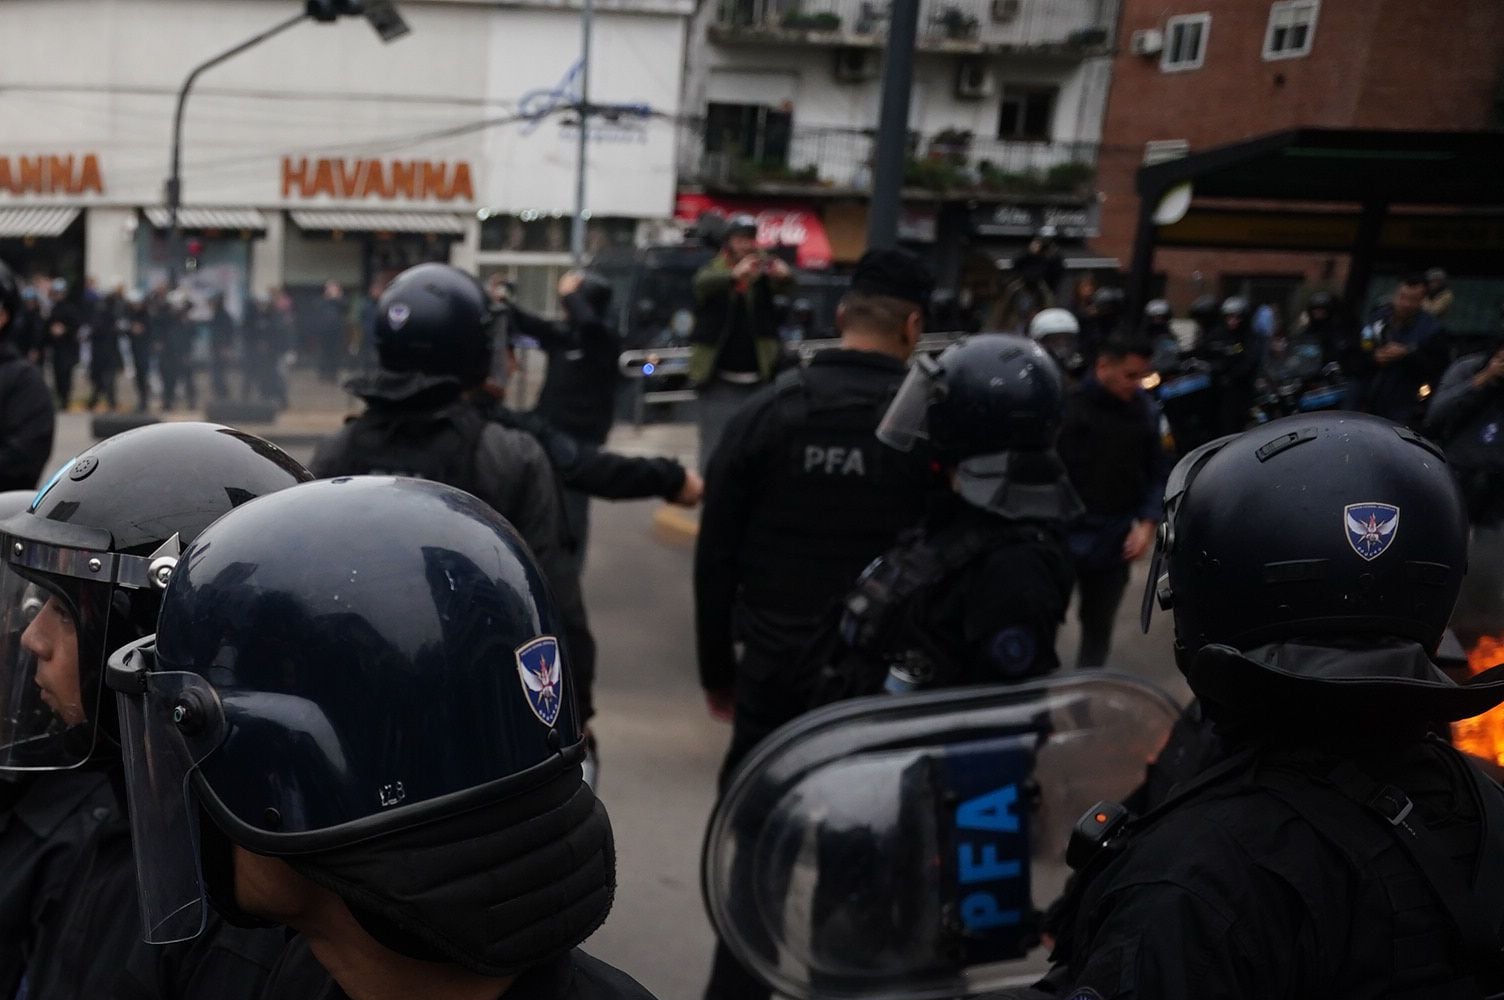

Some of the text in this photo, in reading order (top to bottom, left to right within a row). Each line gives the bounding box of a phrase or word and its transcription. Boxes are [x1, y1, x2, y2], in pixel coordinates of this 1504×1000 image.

[282, 155, 475, 201] HAVANNA
[804, 445, 865, 476] PFA
[955, 782, 1024, 933] PFA
